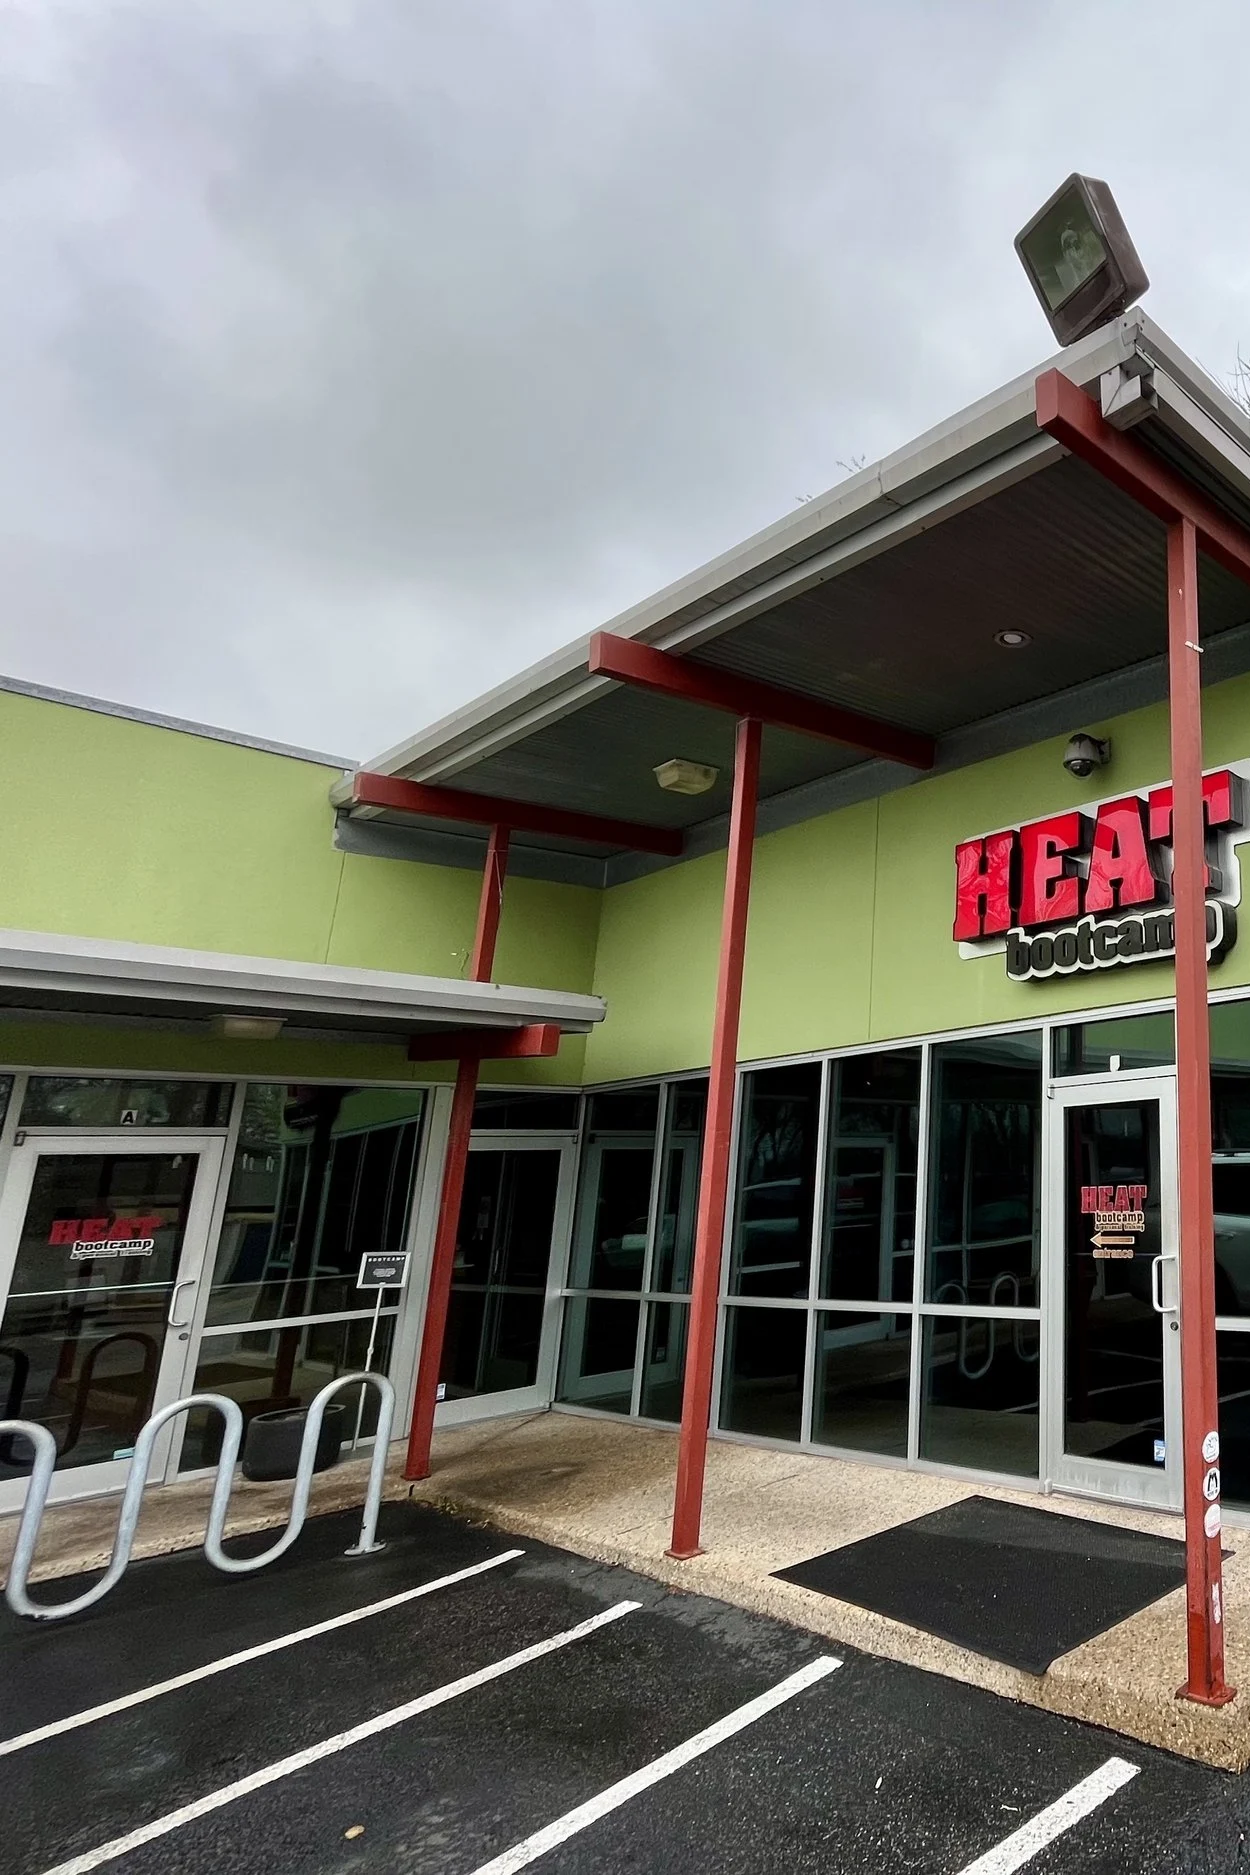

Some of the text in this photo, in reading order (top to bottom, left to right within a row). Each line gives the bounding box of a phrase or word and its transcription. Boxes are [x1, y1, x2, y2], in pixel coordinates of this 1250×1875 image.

[122, 1110, 134, 1124] A
[1081, 1185, 1147, 1213] HEAT
[1095, 1211, 1145, 1223] bootcamp
[50, 1217, 162, 1245] HEAT
[74, 1239, 153, 1253] bootcamp
